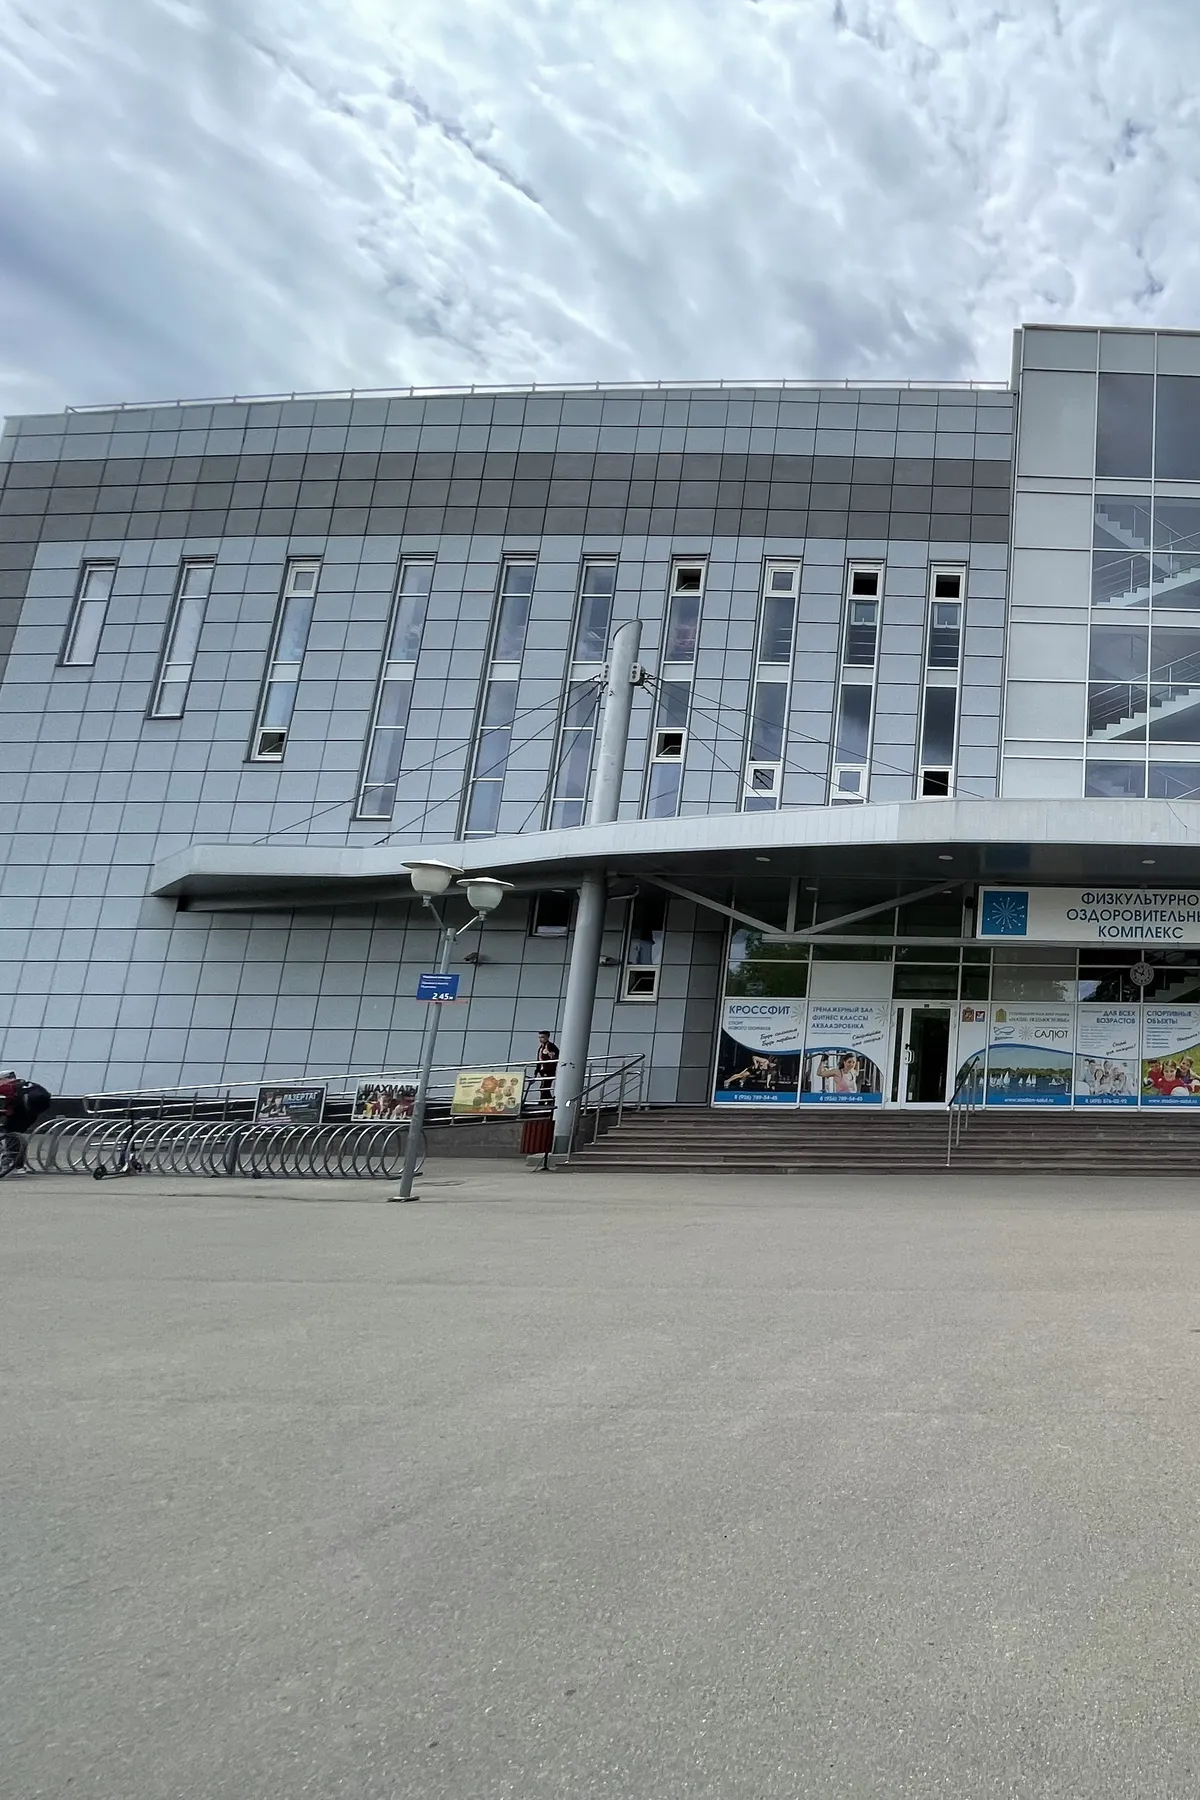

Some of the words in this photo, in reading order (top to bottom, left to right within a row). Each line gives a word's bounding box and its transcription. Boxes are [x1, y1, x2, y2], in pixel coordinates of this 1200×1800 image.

[1098, 924, 1184, 939] КОМПЛЕКС
[729, 1005, 791, 1016] КРОССФИТ
[1034, 1029, 1069, 1041] САЛЮТ
[364, 1083, 419, 1095] ШАХМАТЫ
